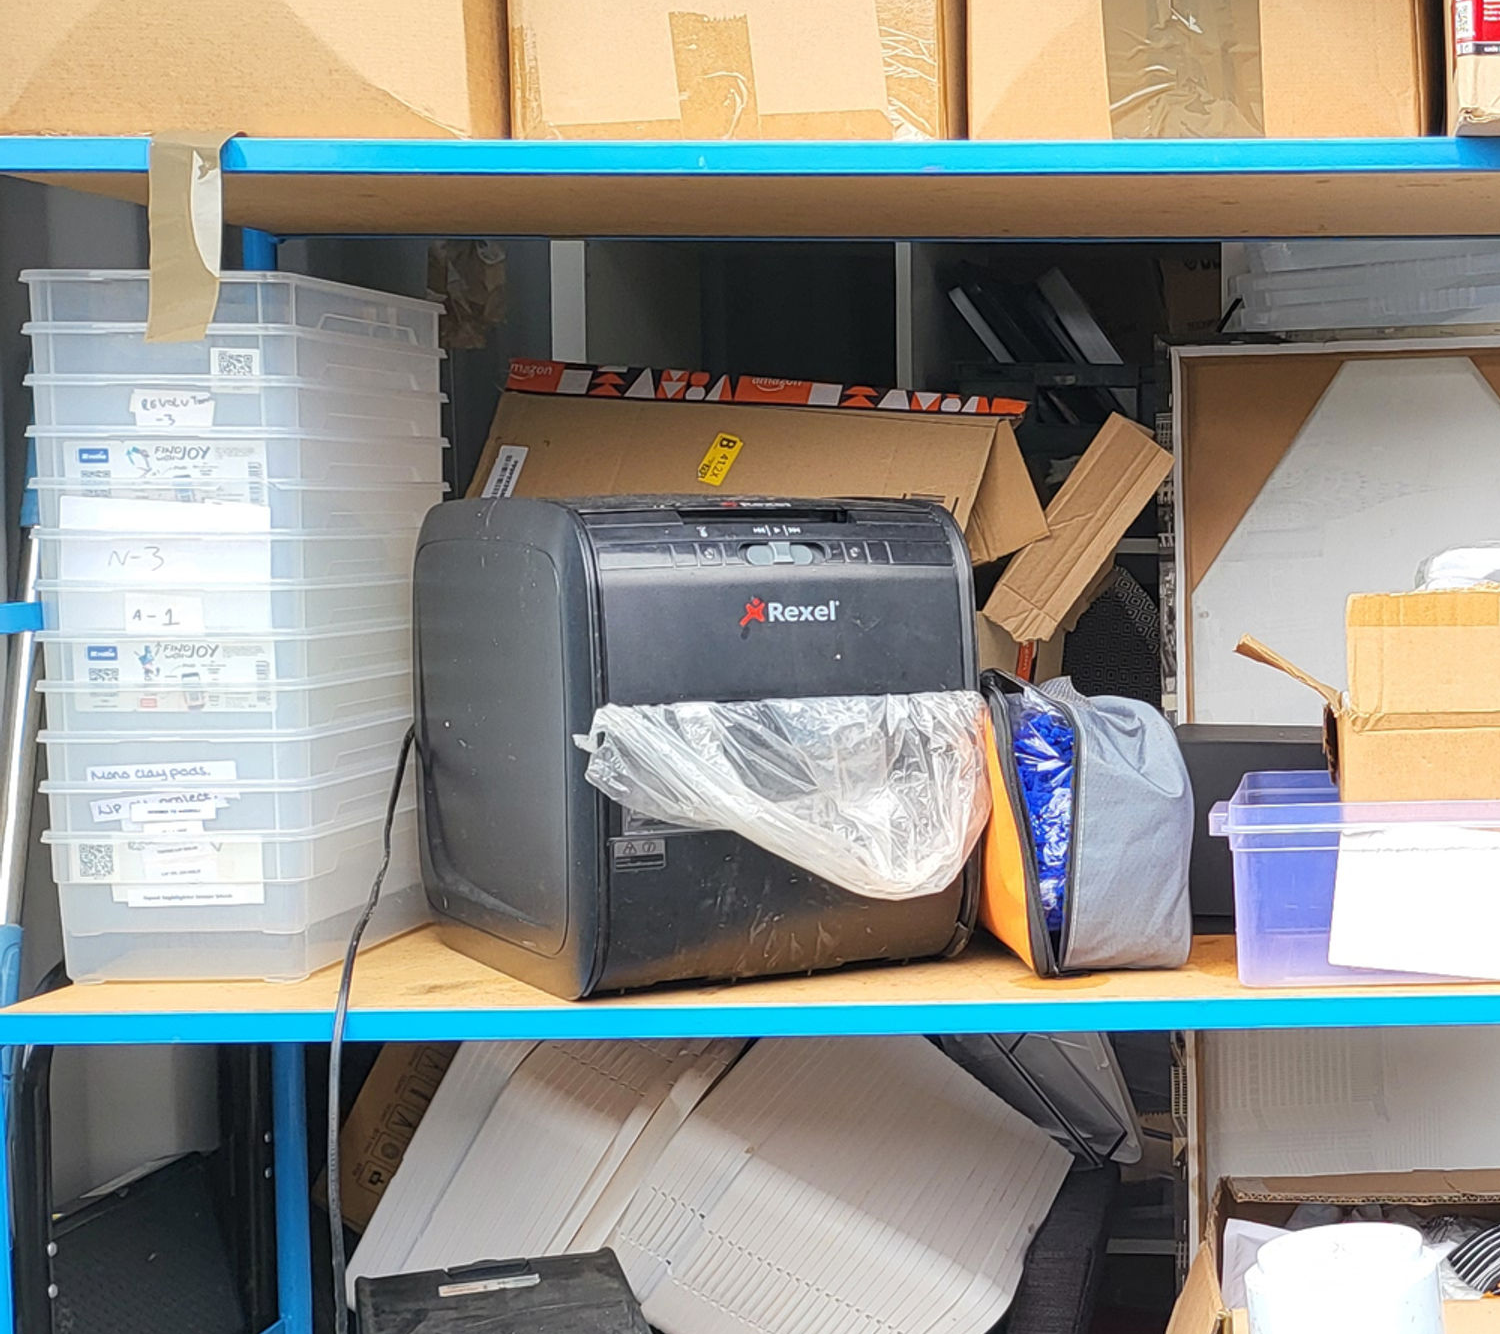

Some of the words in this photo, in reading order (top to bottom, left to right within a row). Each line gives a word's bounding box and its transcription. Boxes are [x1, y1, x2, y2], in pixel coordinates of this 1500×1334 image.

[511, 363, 552, 376] mazon
[718, 436, 736, 450] B
[179, 445, 211, 461] JOY
[768, 600, 837, 622] Rexel
[189, 644, 220, 659] JOY
